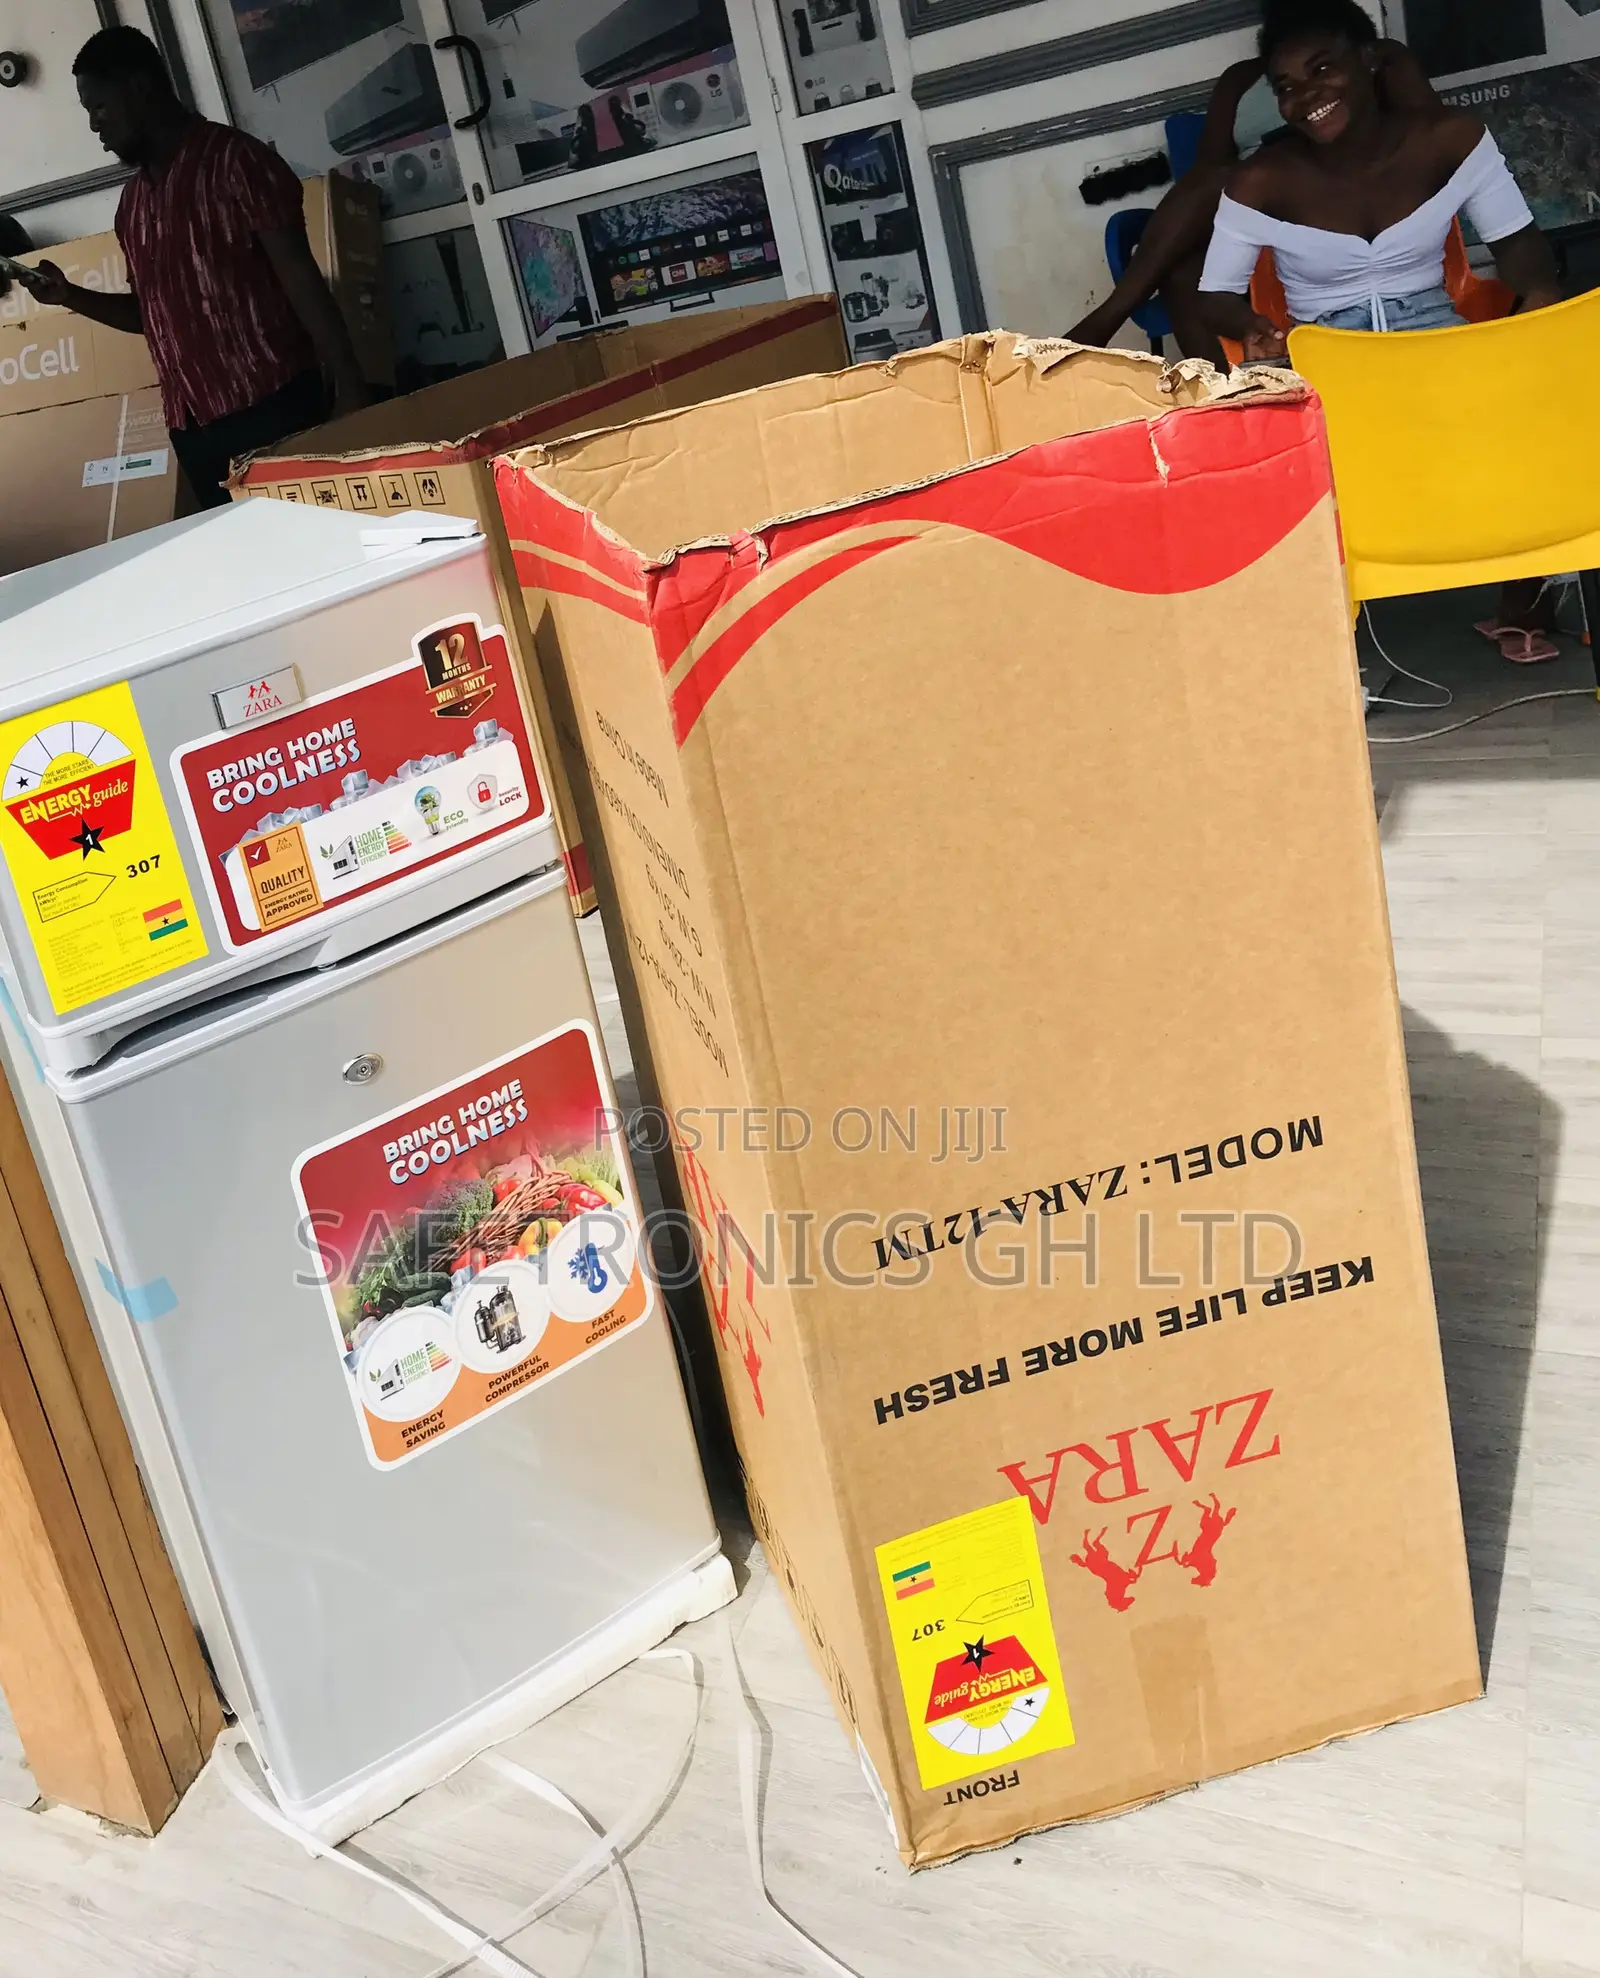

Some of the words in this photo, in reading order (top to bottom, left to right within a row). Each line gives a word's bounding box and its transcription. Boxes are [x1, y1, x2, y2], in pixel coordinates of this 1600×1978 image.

[435, 633, 469, 671] 12
[441, 663, 472, 681] MONTHS
[436, 674, 486, 704] WARRANTY
[242, 694, 283, 718] ZARA
[206, 747, 284, 790] BRING
[286, 718, 356, 760] HOME
[212, 738, 361, 813] COOLNESS
[20, 784, 92, 824] ENERGY
[92, 778, 129, 807] guide
[499, 792, 522, 807] LOCK
[443, 810, 465, 825] ECO
[85, 833, 94, 845] 1
[354, 826, 383, 848] HOME
[357, 840, 386, 858] ENERGY
[125, 854, 162, 879] 307
[260, 866, 305, 894] QUALITY
[264, 895, 288, 910] ENERGY
[287, 887, 309, 900] RATING
[266, 893, 313, 918] APPROVED
[382, 1115, 455, 1163] BRING
[458, 1078, 523, 1126] HOME
[389, 1098, 529, 1185] COOLNESS
[1140, 1115, 1324, 1184] MODEL:
[871, 1164, 1129, 1271] ZARA-12TM
[1261, 1256, 1375, 1307] KEEP
[591, 1309, 615, 1329] FAST
[1155, 1288, 1248, 1338] LIFE
[585, 1315, 627, 1344] COOLING
[400, 1348, 427, 1369] HOME
[1022, 1317, 1144, 1377] MORE
[403, 1359, 428, 1378] ENERGY
[485, 1361, 550, 1403] COMPRESSOR
[488, 1355, 542, 1389] POWERFUL
[873, 1357, 1011, 1426] FRESH
[401, 1409, 444, 1439] ENERGY
[406, 1421, 446, 1448] SAVING
[997, 1388, 1281, 1526] ZARA
[912, 1619, 946, 1641] 307
[934, 1682, 969, 1708] guide
[969, 1667, 1036, 1702] ENERGY
[943, 1769, 1020, 1806] FRONT
